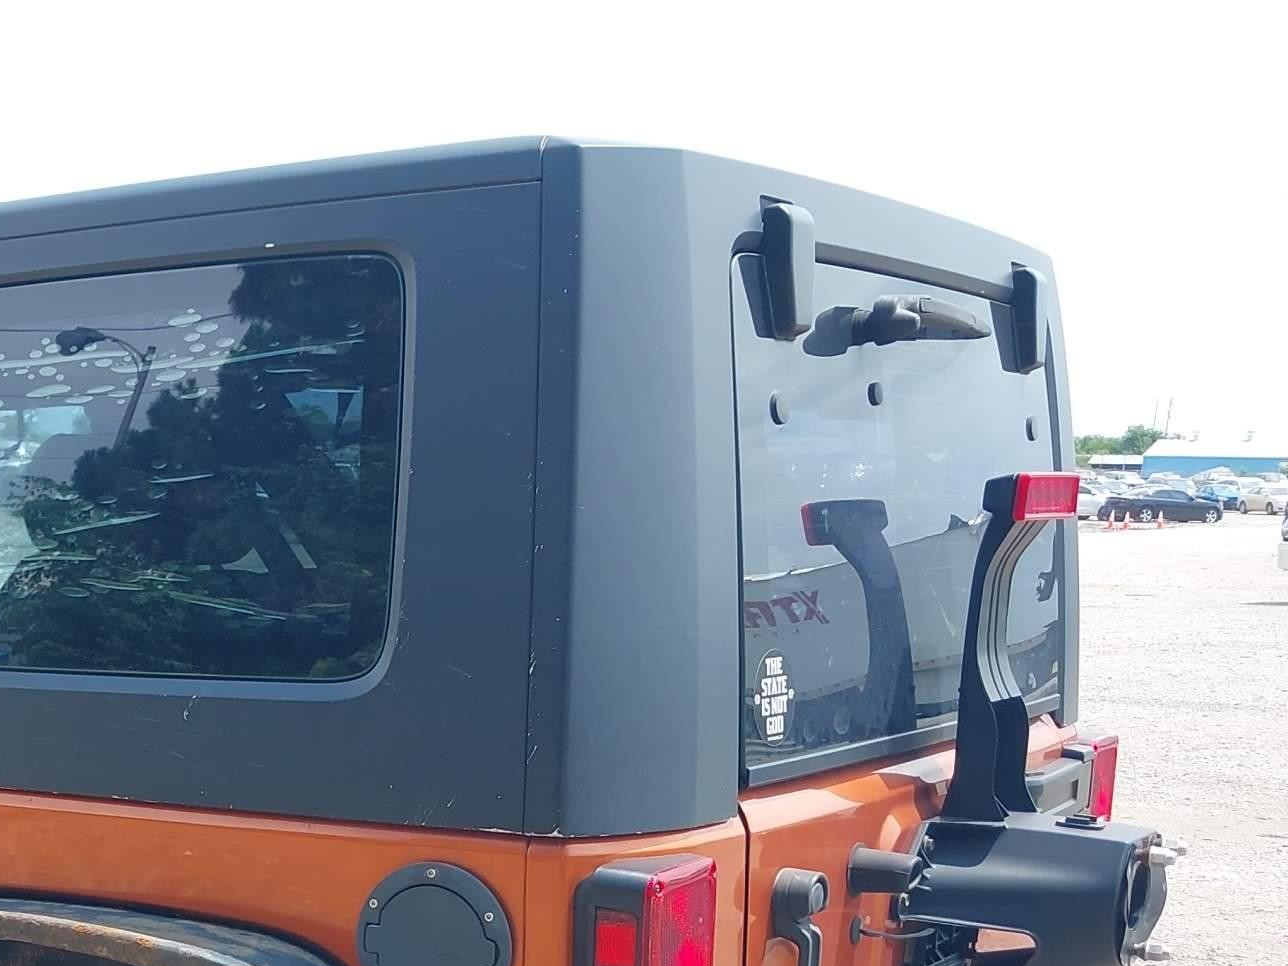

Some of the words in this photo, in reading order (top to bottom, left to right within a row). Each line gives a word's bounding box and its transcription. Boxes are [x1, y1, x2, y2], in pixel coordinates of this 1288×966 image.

[765, 656, 783, 676] THE
[761, 675, 788, 697] STATE
[761, 698, 771, 717] IS
[771, 694, 788, 715] NOT
